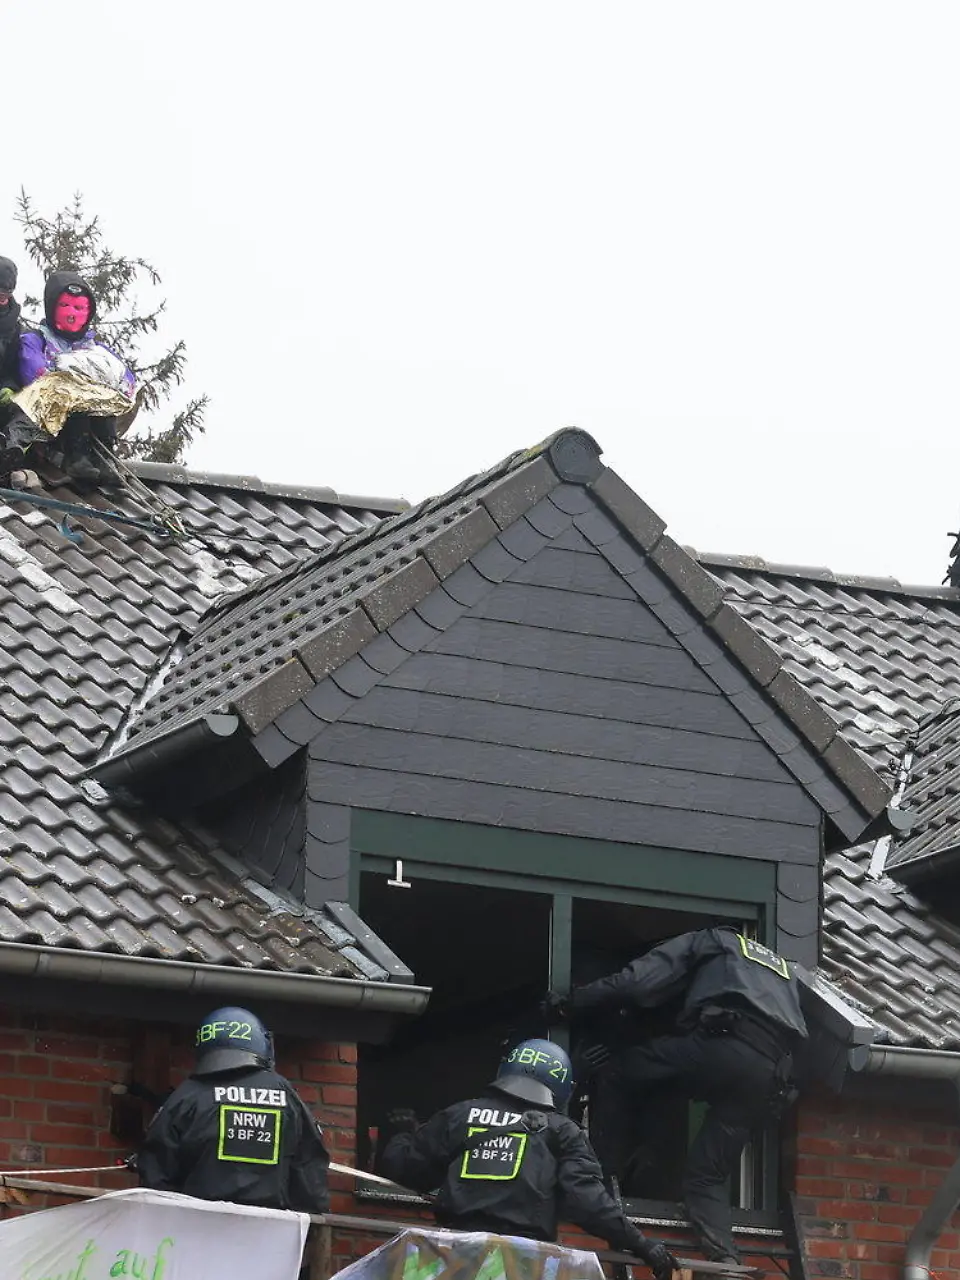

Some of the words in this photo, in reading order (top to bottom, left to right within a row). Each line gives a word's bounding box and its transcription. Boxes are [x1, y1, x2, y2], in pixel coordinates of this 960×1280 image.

[214, 1086, 287, 1107] POLIZEI
[233, 1112, 266, 1128] NRW
[467, 1107, 523, 1127] POLIZ
[227, 1128, 235, 1139] 3
[237, 1129, 254, 1141] BF
[257, 1131, 271, 1142] 22
[471, 1148, 479, 1159] 3
[482, 1149, 499, 1160] BF
[500, 1151, 514, 1162] 21
